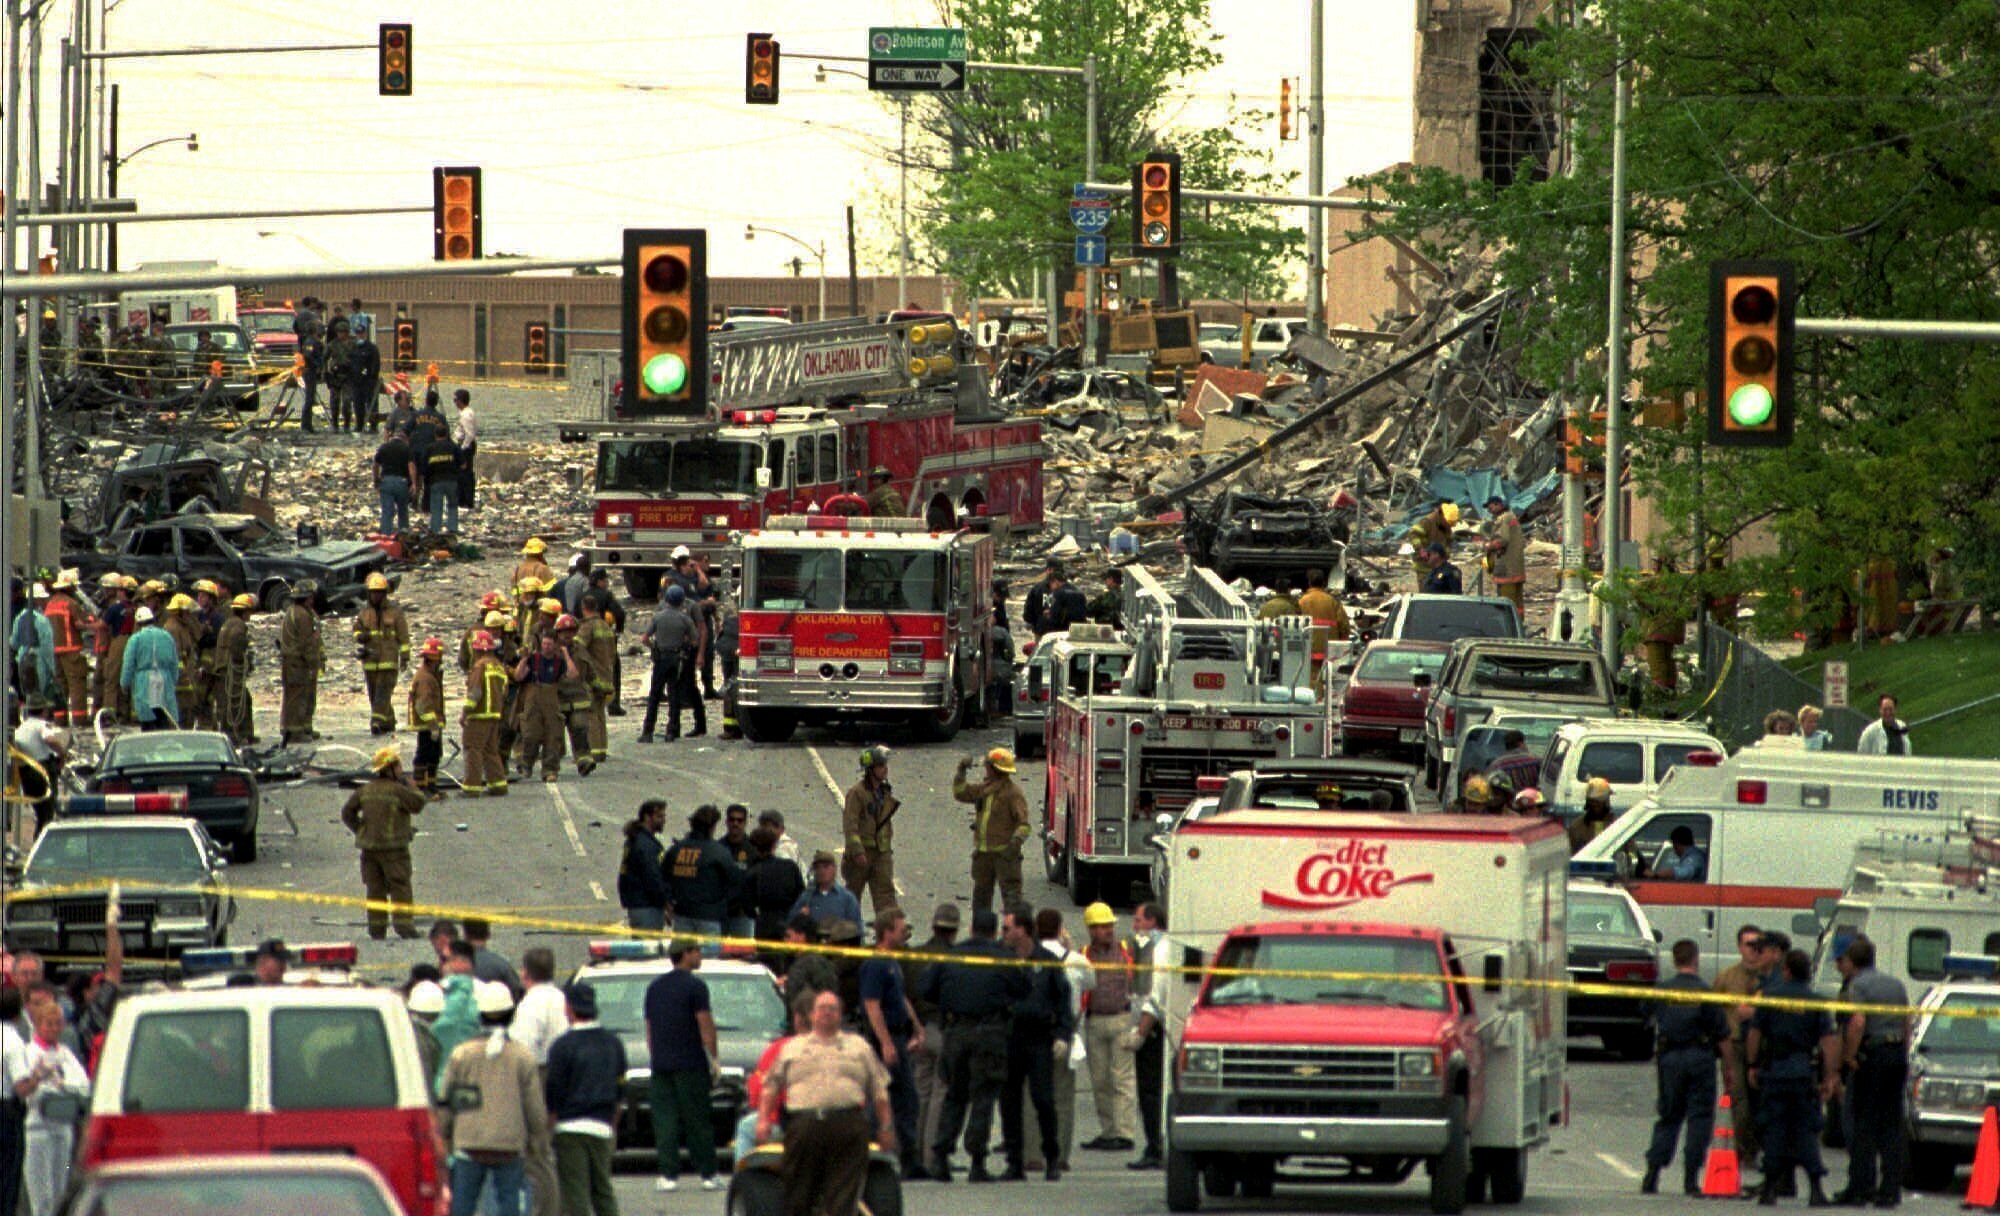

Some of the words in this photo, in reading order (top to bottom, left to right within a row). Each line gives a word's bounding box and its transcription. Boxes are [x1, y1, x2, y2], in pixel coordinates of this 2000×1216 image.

[893, 33, 945, 49] Robinson
[881, 69, 905, 80] ONE
[914, 69, 939, 80] WAY
[1076, 210, 1108, 226] 235
[803, 347, 862, 377] OKLAHOMA
[864, 344, 888, 369] CITY
[640, 513, 661, 523] FIRE
[795, 614, 857, 625] OKLAHOMA
[860, 615, 885, 625] CITY
[793, 647, 816, 657] FIRE
[818, 648, 889, 658] DEPARTMENT
[1162, 719, 1187, 730] KEEP
[1222, 720, 1241, 730] 200
[1882, 788, 1939, 811] REVIS
[675, 847, 702, 864] ATF
[1336, 839, 1388, 865] diet
[1296, 853, 1395, 899] Coke
